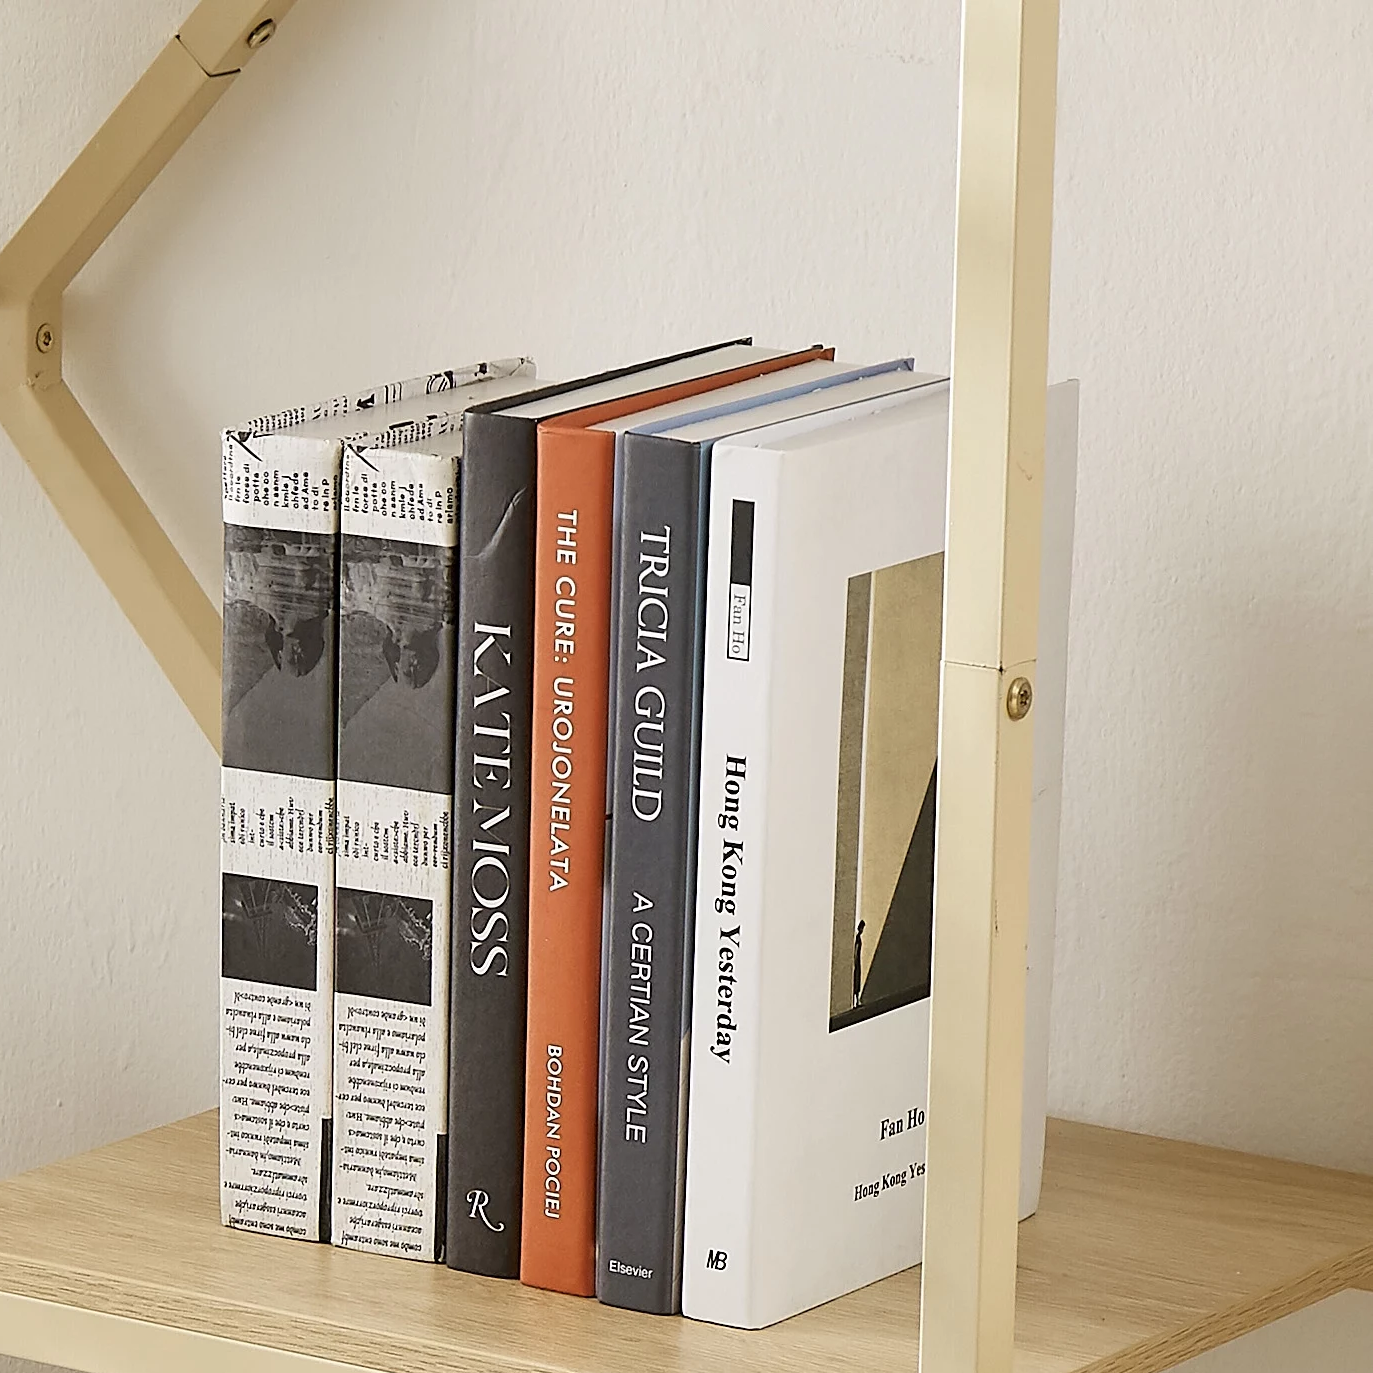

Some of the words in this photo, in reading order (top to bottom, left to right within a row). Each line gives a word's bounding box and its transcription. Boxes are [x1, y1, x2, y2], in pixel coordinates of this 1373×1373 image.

[555, 509, 578, 566] THE
[553, 576, 577, 663] CURE:
[636, 525, 671, 673] TRICIA
[733, 594, 746, 625] Fan
[732, 631, 745, 654] Ho
[471, 621, 512, 790] KATE
[549, 676, 575, 892] UROJONELATA
[632, 686, 666, 822] GUILD
[717, 754, 747, 831] Hong
[469, 799, 512, 977] MOSS
[632, 891, 654, 913] A
[714, 838, 744, 916] Kong
[628, 922, 653, 1046] CERTIAN
[709, 925, 741, 1065] Yesterday
[546, 1044, 563, 1140] BOHDAN
[625, 1054, 649, 1144] STYLE
[880, 1118, 903, 1141] Fan
[907, 1107, 925, 1130] Ho
[465, 1188, 505, 1232] R
[544, 1146, 561, 1219] POCIEJ
[854, 1181, 880, 1201] Hong
[881, 1170, 907, 1191] Kong
[608, 1259, 654, 1280] Elsevier
